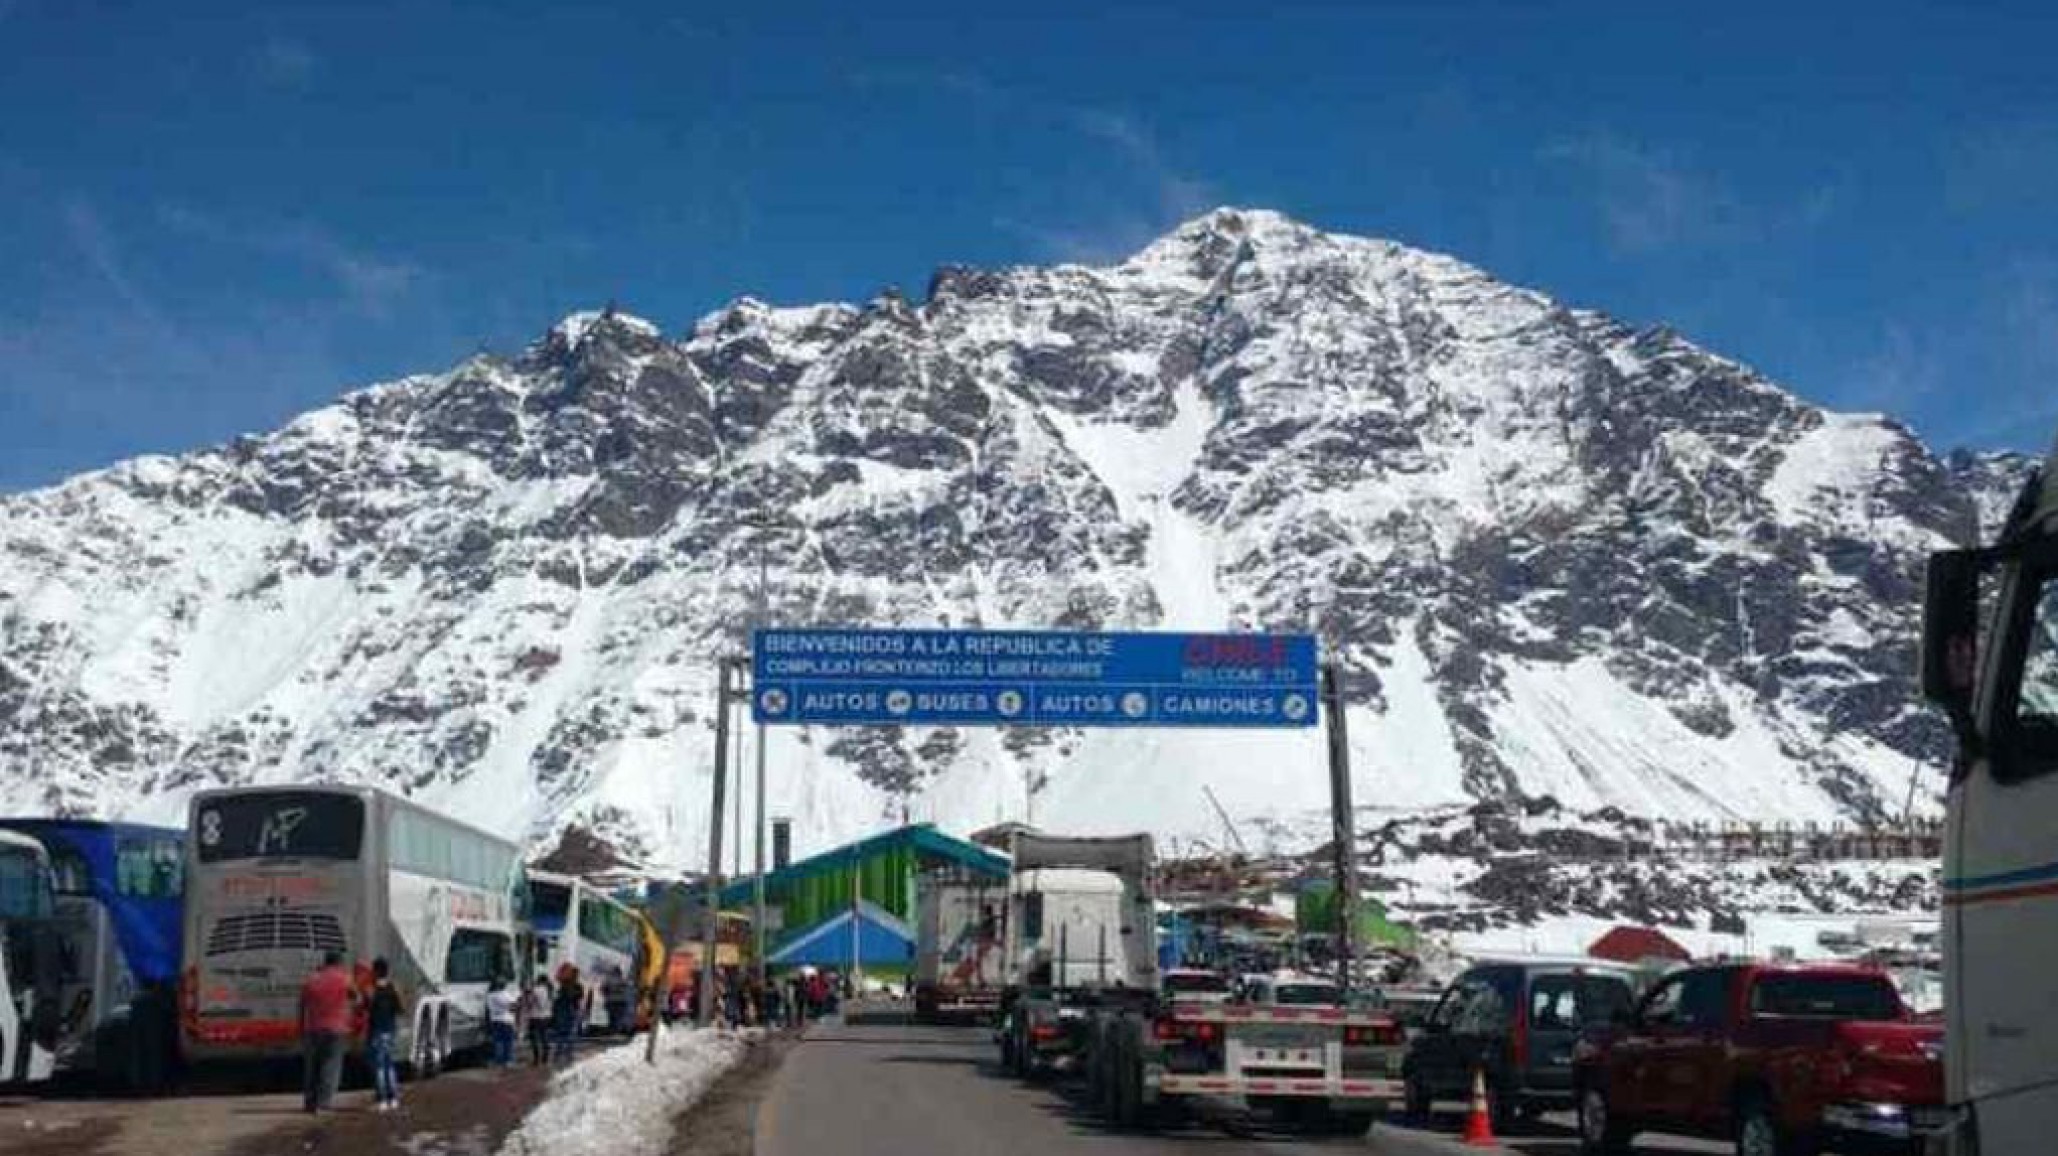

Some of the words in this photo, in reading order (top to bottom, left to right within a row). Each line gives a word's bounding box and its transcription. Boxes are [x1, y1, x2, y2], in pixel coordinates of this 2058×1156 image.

[765, 634, 905, 654] BIENVENIDOS
[911, 636, 927, 655] A
[931, 636, 959, 655] LA
[964, 636, 1080, 655] REPUBLICA
[1086, 637, 1115, 655] DE
[804, 693, 877, 710] AUTOS
[917, 694, 989, 711] BUSES
[1041, 695, 1115, 712] AUTOS
[1163, 696, 1275, 714] CAMIONES
